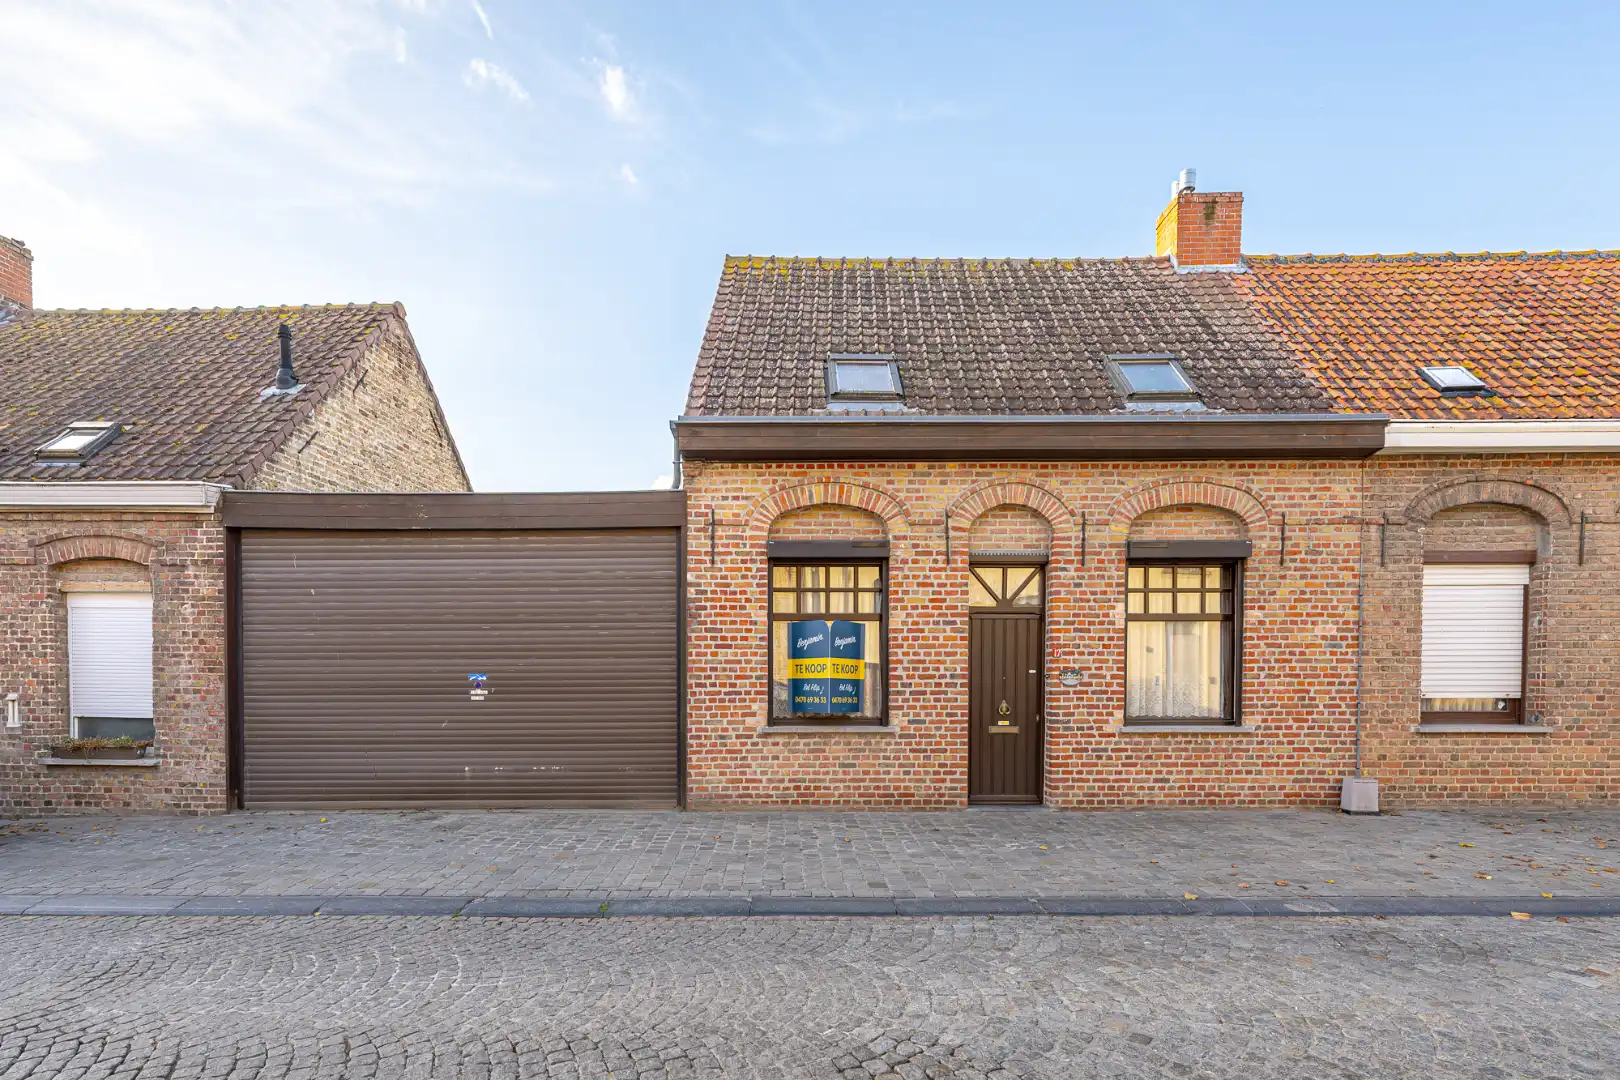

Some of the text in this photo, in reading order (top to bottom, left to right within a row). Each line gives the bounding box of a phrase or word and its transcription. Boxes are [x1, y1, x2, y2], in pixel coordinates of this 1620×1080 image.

[795, 664, 826, 674] TE KOOP
[832, 664, 858, 674] TE KOOP
